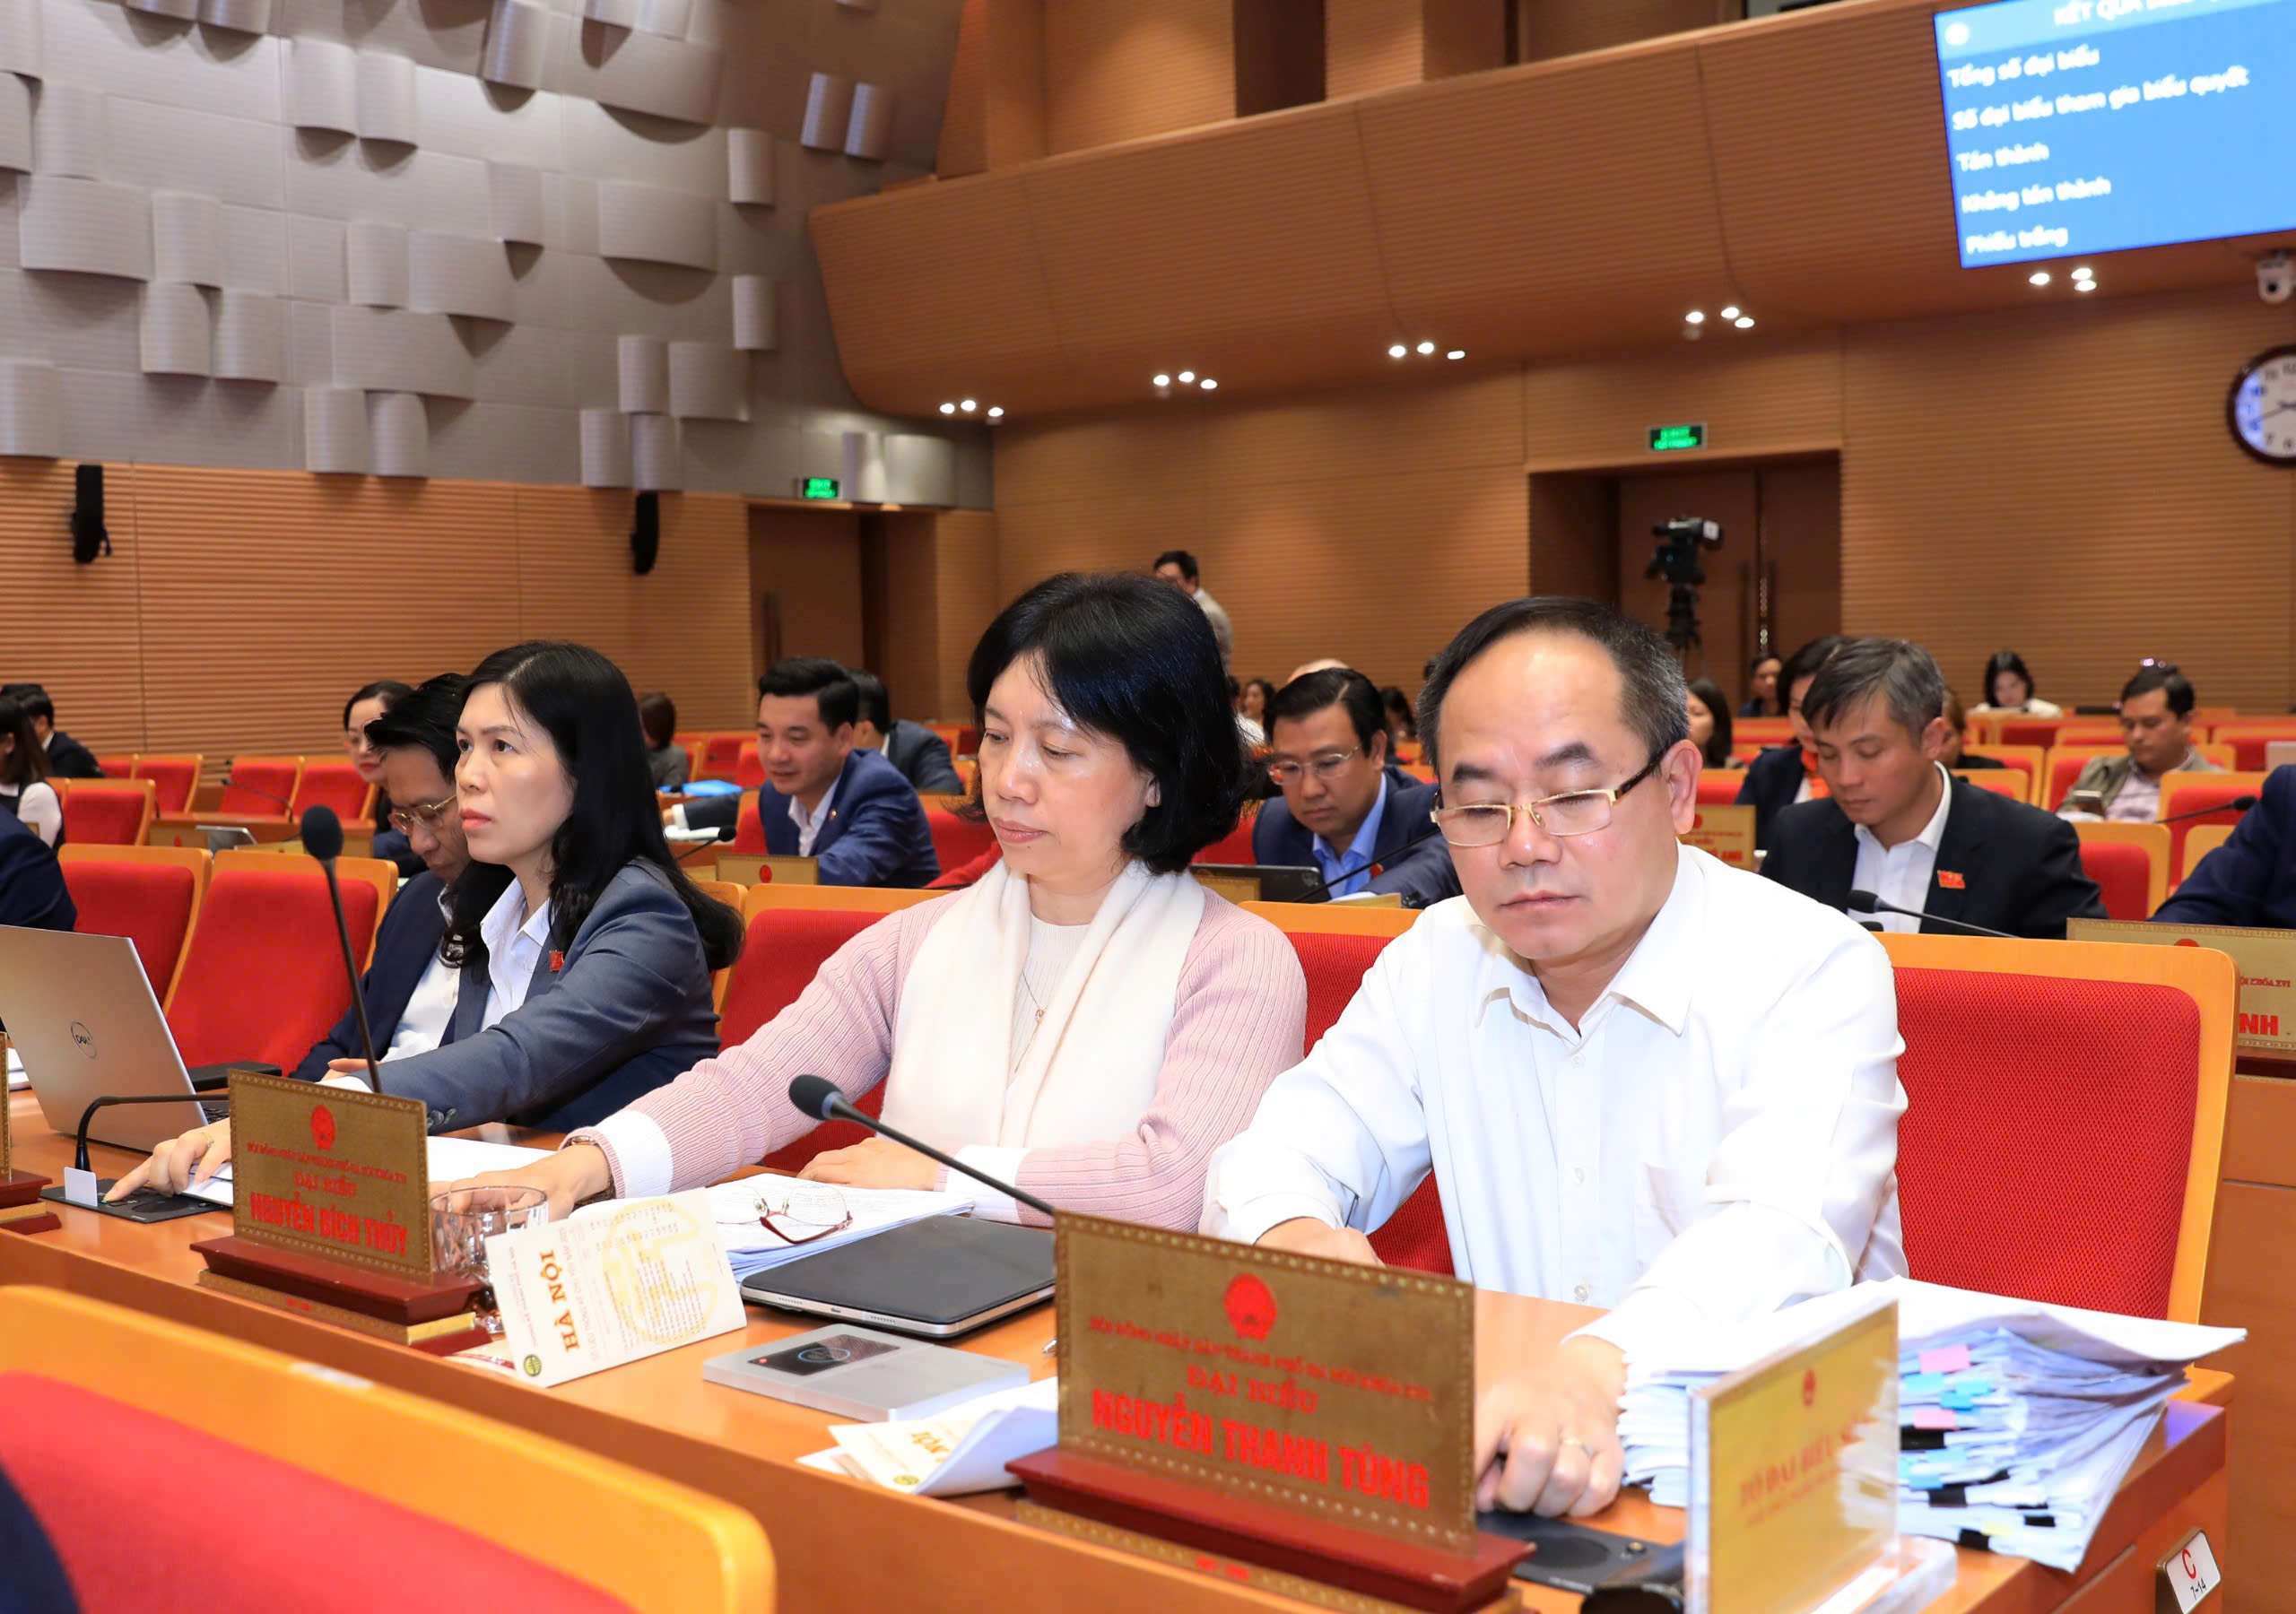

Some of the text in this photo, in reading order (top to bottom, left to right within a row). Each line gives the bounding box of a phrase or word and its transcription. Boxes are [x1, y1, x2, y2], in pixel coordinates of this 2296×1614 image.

[2239, 1012, 2279, 1037] NH
[539, 1249, 581, 1352] HÀ NỘI
[1187, 1365, 1238, 1396] ĐẠI
[1092, 1389, 1430, 1509] NGUYỄN THANH TÙNG
[2181, 1549, 2196, 1579] C
[2189, 1577, 2206, 1601] 7-14
